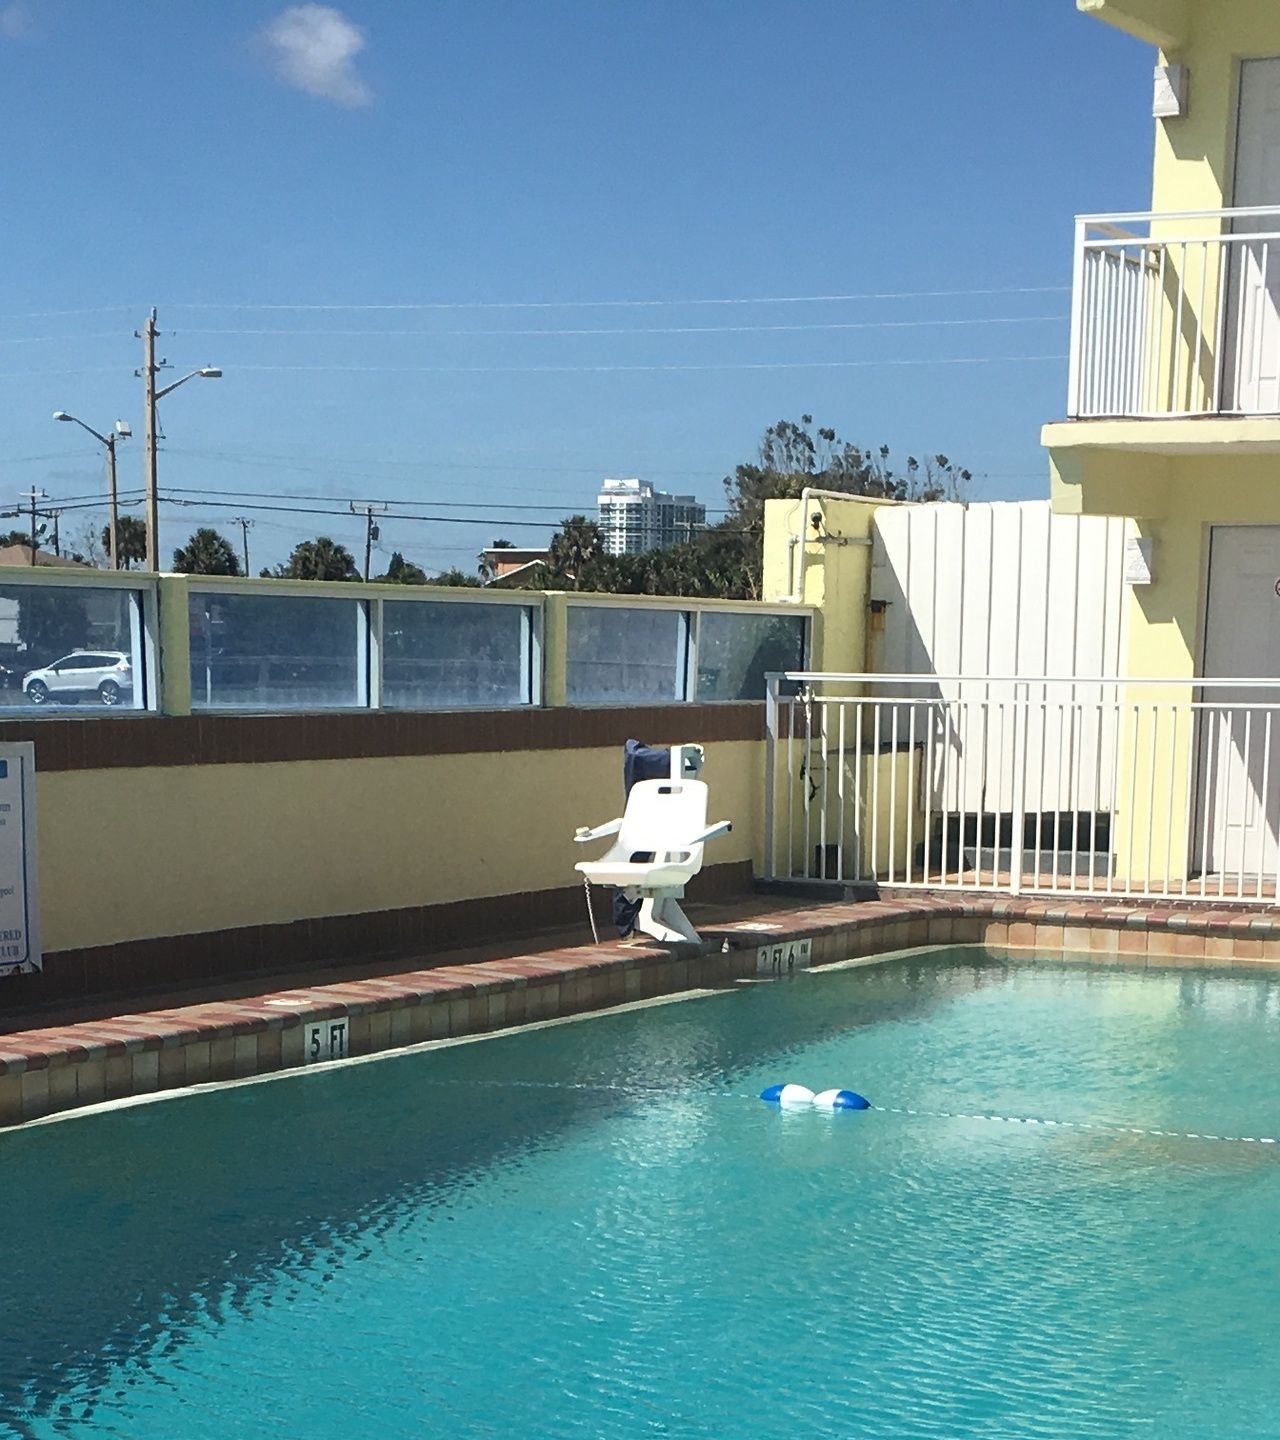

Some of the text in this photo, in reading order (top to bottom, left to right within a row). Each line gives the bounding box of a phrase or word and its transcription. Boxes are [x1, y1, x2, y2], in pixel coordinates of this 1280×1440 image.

[1, 886, 15, 899] pool
[773, 948, 783, 974] FT
[788, 945, 795, 968] 6
[311, 1024, 346, 1058] 5 FT
